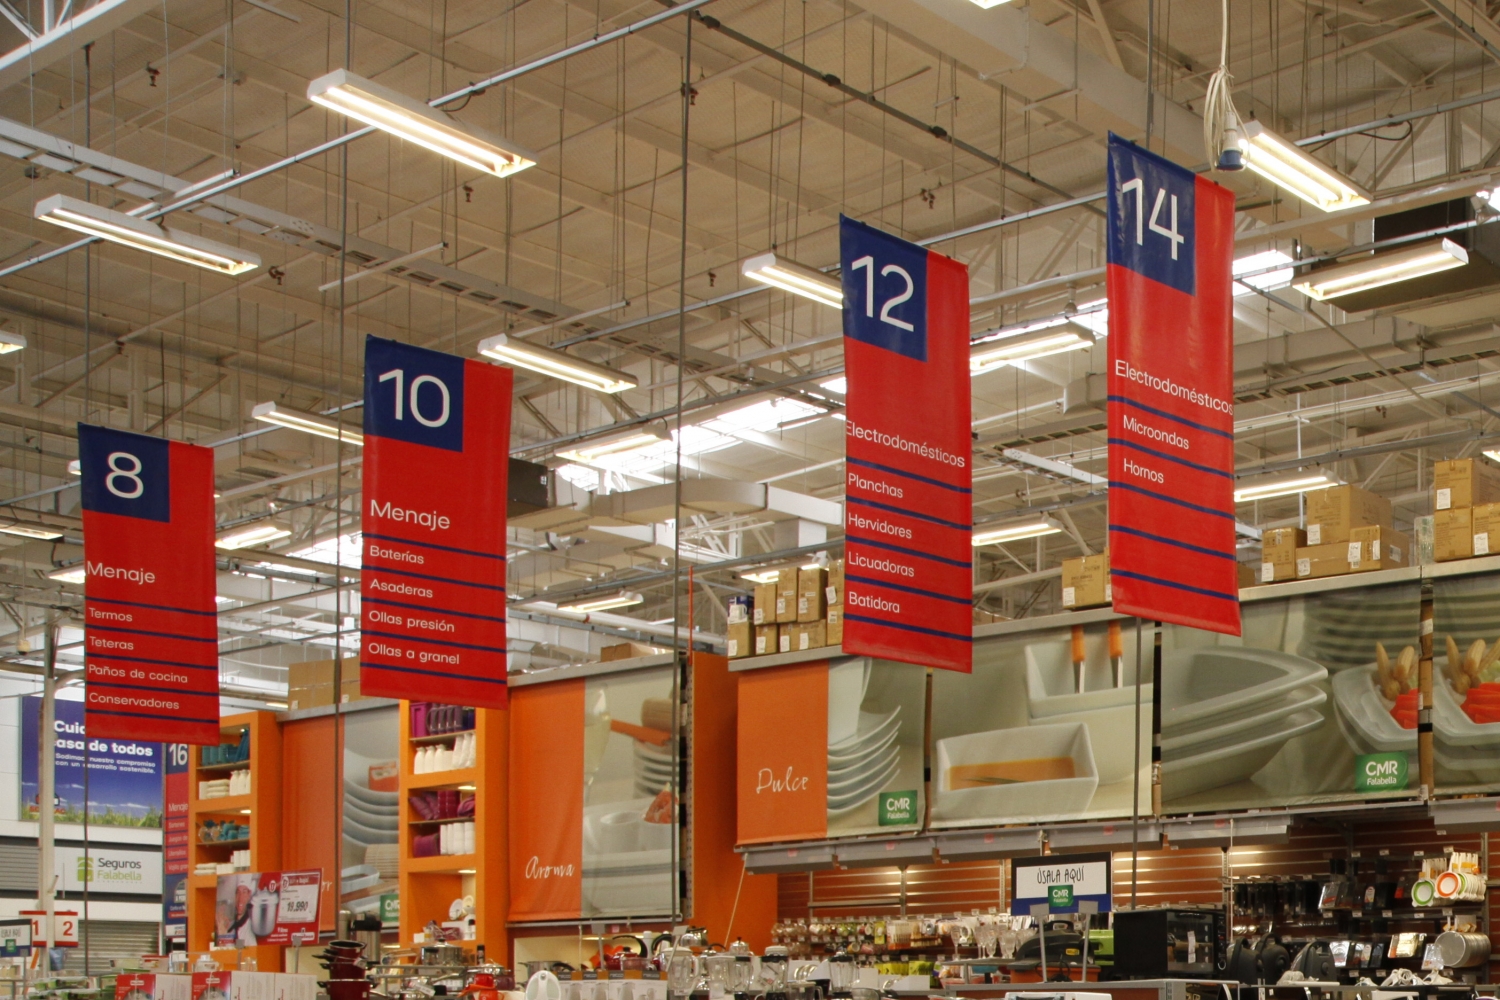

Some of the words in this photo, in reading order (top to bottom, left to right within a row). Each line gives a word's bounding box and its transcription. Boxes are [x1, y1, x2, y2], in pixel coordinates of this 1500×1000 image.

[1122, 178, 1184, 260] 14
[851, 255, 915, 332] 12
[1115, 359, 1233, 415] Electrodomésticos
[378, 369, 450, 428] 10
[1123, 414, 1190, 449] Microondas
[846, 419, 965, 469] Electrodomésticos
[105, 451, 144, 498] 8
[1123, 457, 1164, 484] Hornos
[848, 473, 904, 499] Planchas
[371, 500, 450, 530] Menaje
[848, 513, 912, 540] Hervidores
[370, 546, 425, 564] Baterías
[848, 551, 914, 578] Licuadoras
[87, 561, 156, 584] Menaje
[370, 579, 433, 598] Asaderas
[848, 591, 900, 614] Batidora
[89, 607, 132, 622] Termos
[369, 610, 403, 626] Ollas
[407, 616, 455, 633] presión
[89, 637, 134, 651] Teteras
[369, 643, 402, 658] Ollas
[406, 650, 415, 659] a
[419, 653, 459, 666] granel
[88, 664, 126, 677] Paños
[130, 669, 145, 679] de
[149, 672, 188, 683] cocina
[89, 693, 179, 710] Conservadores
[89, 740, 108, 752] de
[112, 743, 153, 756] todos
[169, 744, 188, 766] 16
[120, 766, 155, 774] sostenible.
[1365, 760, 1398, 777] CMR
[756, 766, 809, 794] Dulce
[1366, 775, 1396, 786] Falabella
[886, 798, 910, 811] CMR
[887, 809, 910, 819] Falabella
[98, 858, 141, 870] Seguros
[525, 856, 575, 880] Aroma
[1037, 868, 1060, 884] ÚSALA
[1065, 865, 1084, 883] AQUÍ
[98, 871, 142, 880] Falabella
[32, 921, 38, 935] 1
[63, 921, 73, 936] 2
